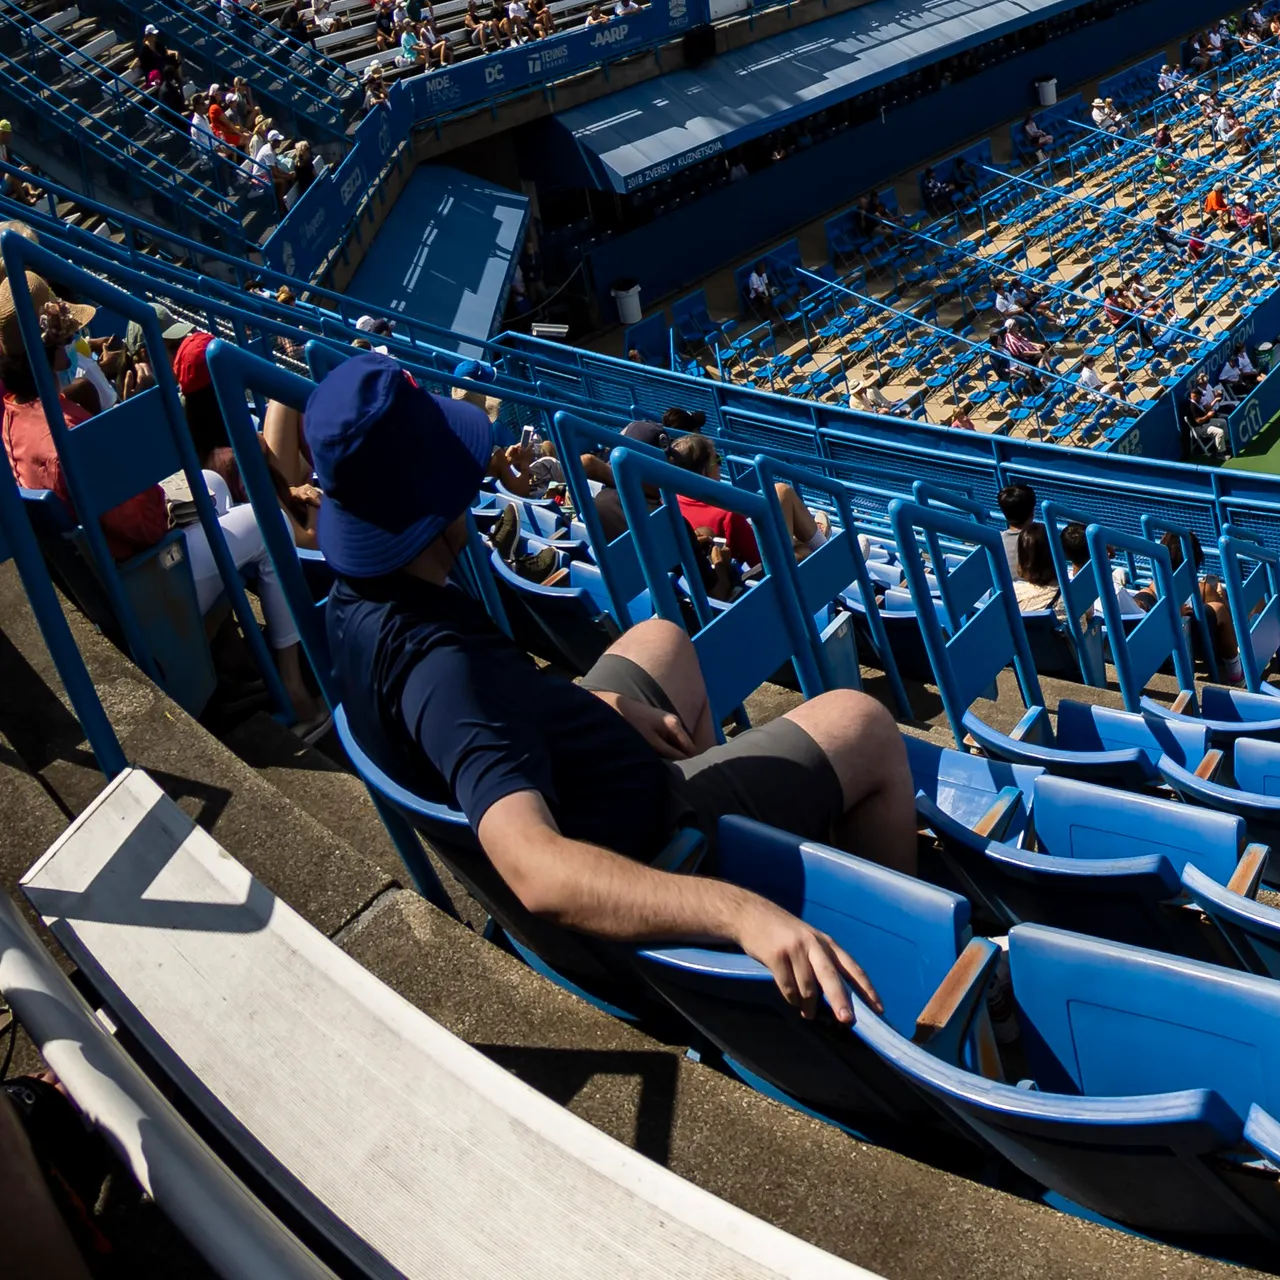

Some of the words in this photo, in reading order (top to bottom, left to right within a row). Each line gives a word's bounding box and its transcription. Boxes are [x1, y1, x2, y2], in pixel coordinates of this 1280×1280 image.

[590, 25, 629, 48] AARP
[540, 45, 568, 63] TENNIS
[426, 73, 454, 92] MDE.
[485, 64, 504, 84] DC
[426, 84, 461, 105] TENNIS
[627, 173, 643, 189] 2018
[645, 162, 671, 181] ZVEREV
[677, 141, 723, 167] KUZNETSOVA
[1239, 402, 1263, 443] citi
